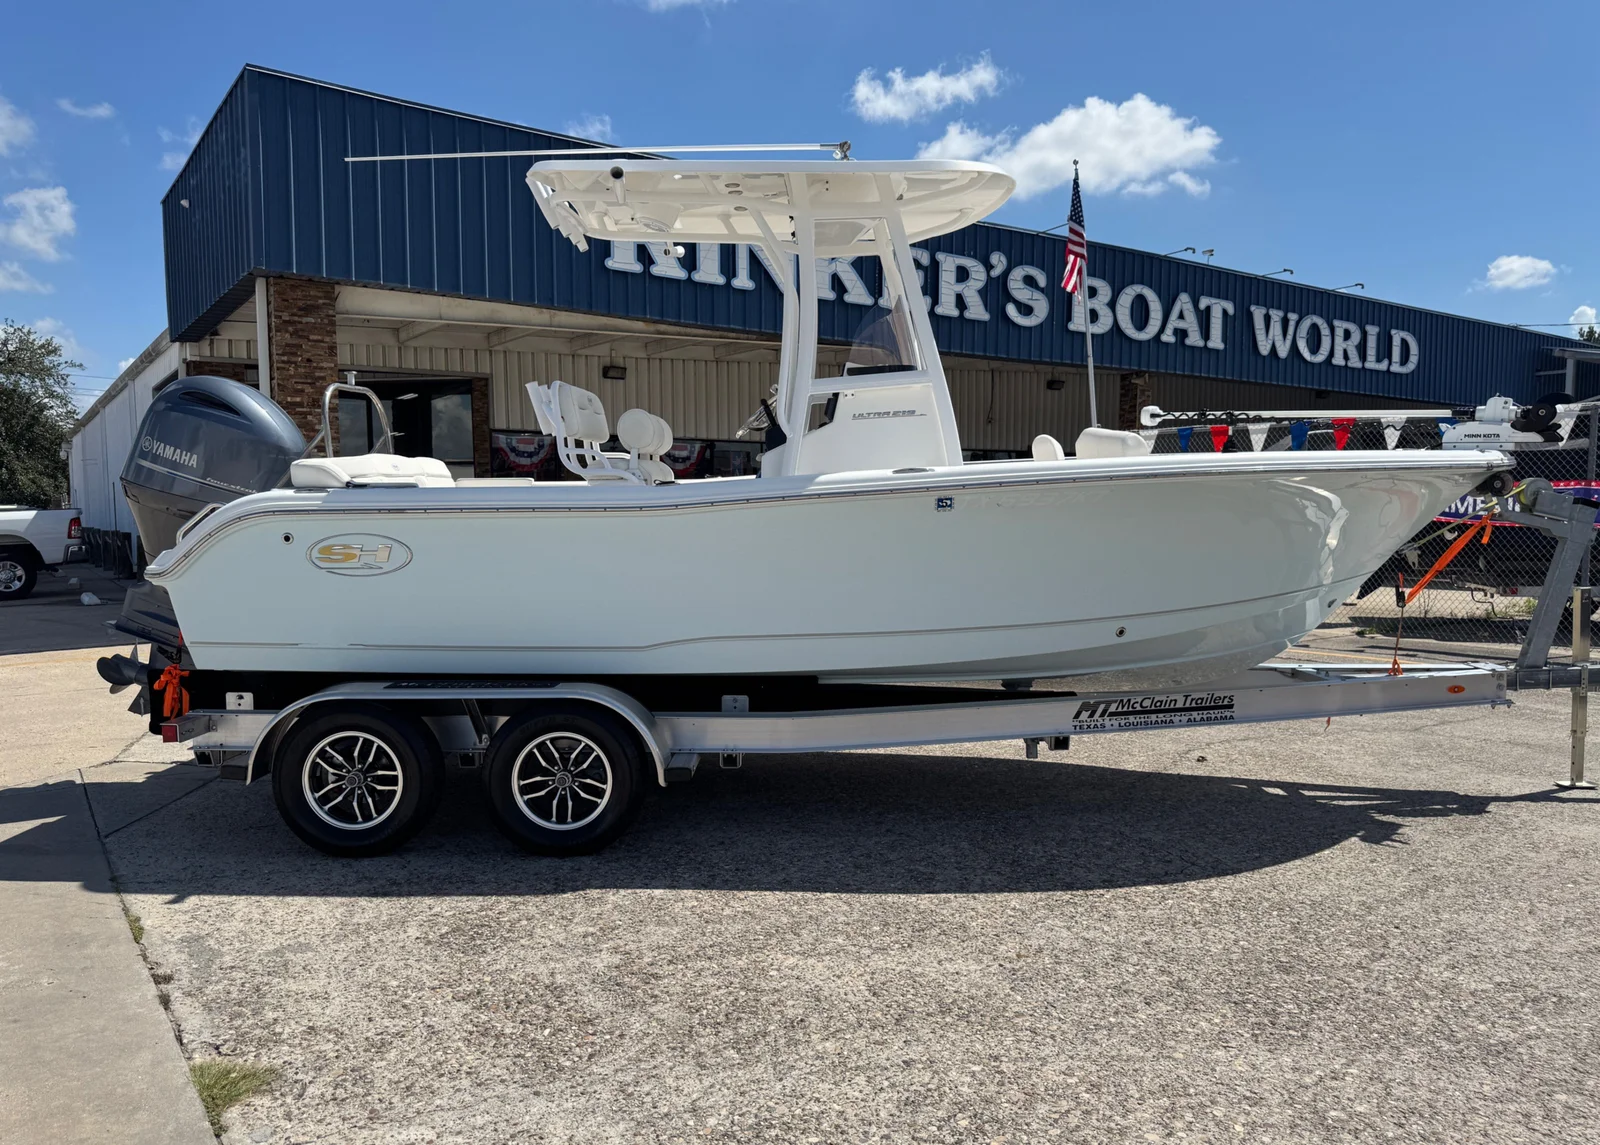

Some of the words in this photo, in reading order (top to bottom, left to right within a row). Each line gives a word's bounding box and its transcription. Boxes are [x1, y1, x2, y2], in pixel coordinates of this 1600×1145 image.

[1067, 276, 1235, 350] BOAT
[1250, 304, 1420, 374] WORLD
[852, 411, 891, 419] ULTRA
[151, 441, 198, 469] YAMAHA
[315, 544, 393, 563] SH
[1072, 700, 1119, 719] MT
[1115, 696, 1176, 711] McClain
[1182, 693, 1235, 707] Trailers
[1072, 723, 1106, 731] TEXAS
[1118, 719, 1175, 728] LOUISIANA
[1186, 714, 1235, 724] ALABAMA
